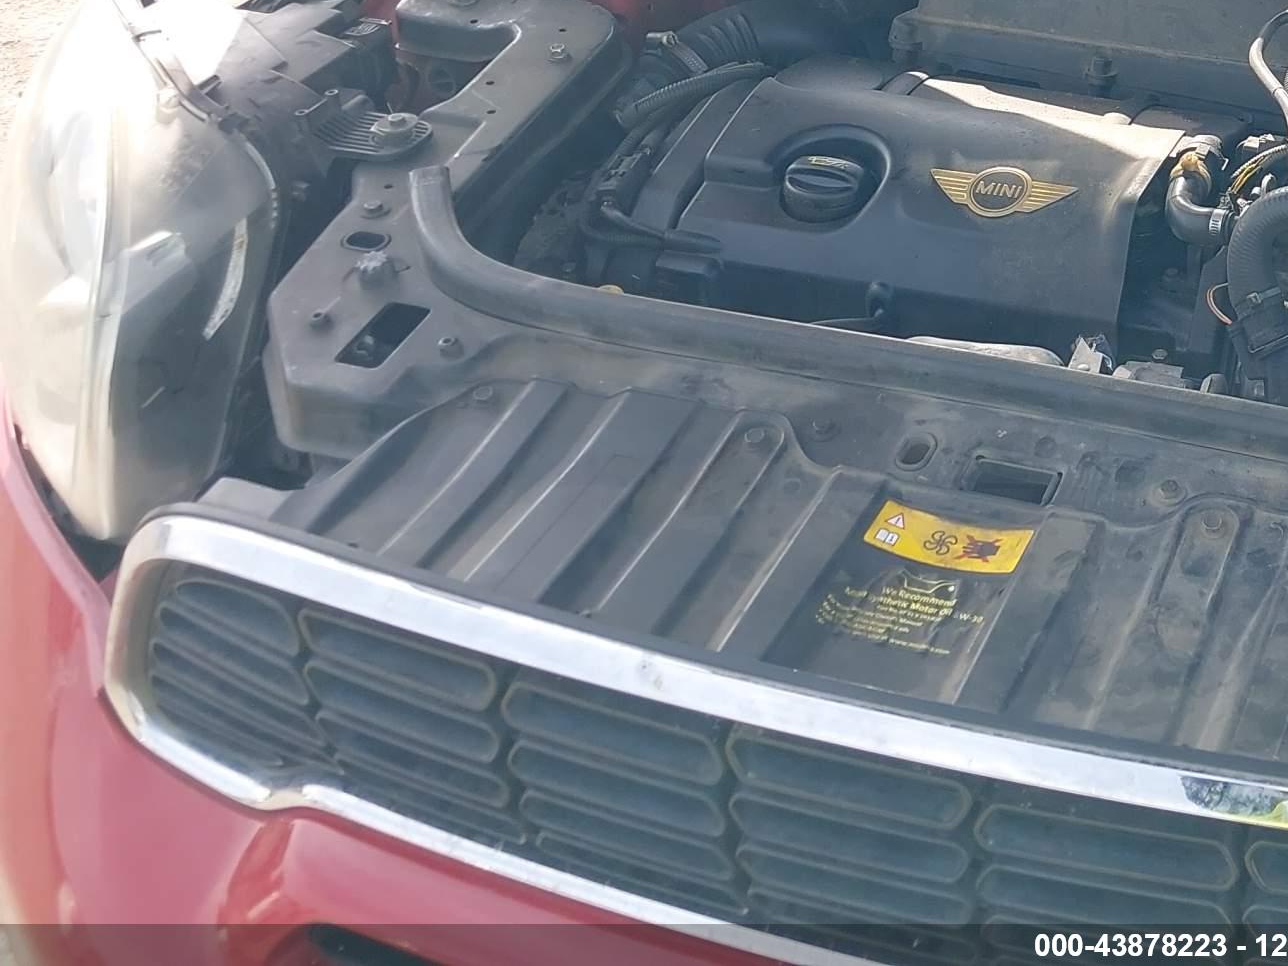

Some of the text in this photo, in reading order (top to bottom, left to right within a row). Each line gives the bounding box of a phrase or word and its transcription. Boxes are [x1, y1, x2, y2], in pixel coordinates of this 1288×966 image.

[975, 180, 1023, 199] MINI
[898, 588, 958, 608] Recommend
[910, 601, 938, 615] Motor
